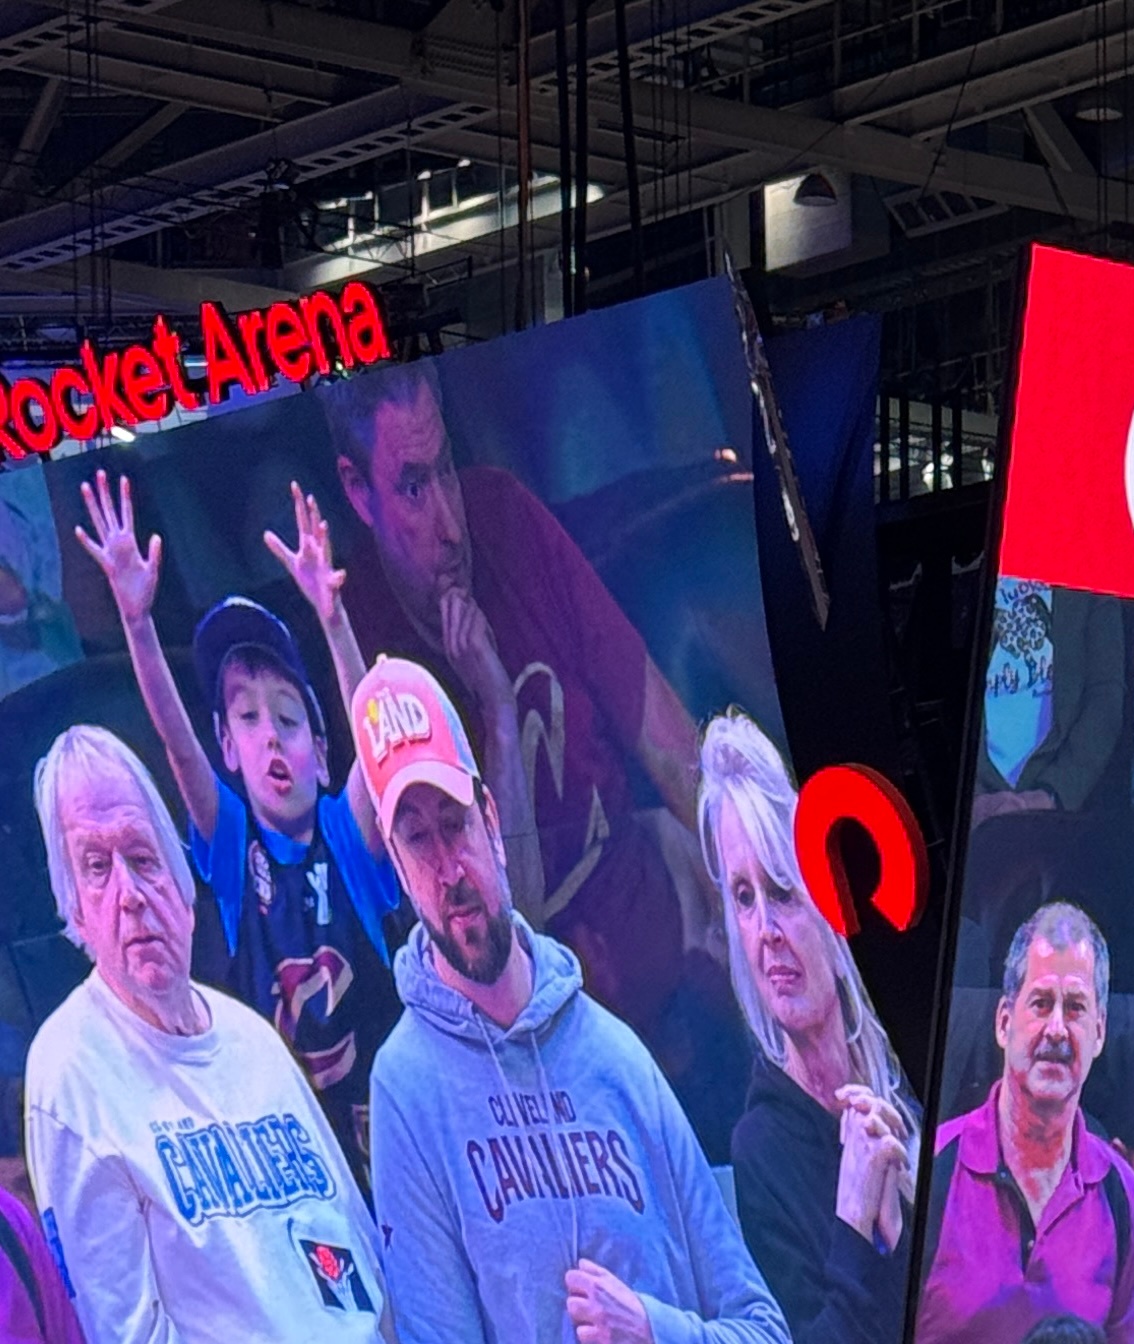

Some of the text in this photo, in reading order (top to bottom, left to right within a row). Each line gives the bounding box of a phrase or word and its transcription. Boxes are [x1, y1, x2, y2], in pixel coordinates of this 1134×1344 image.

[199, 280, 391, 406] Arena
[362, 686, 432, 763] LAND
[466, 1129, 645, 1224] CAVALIERS
